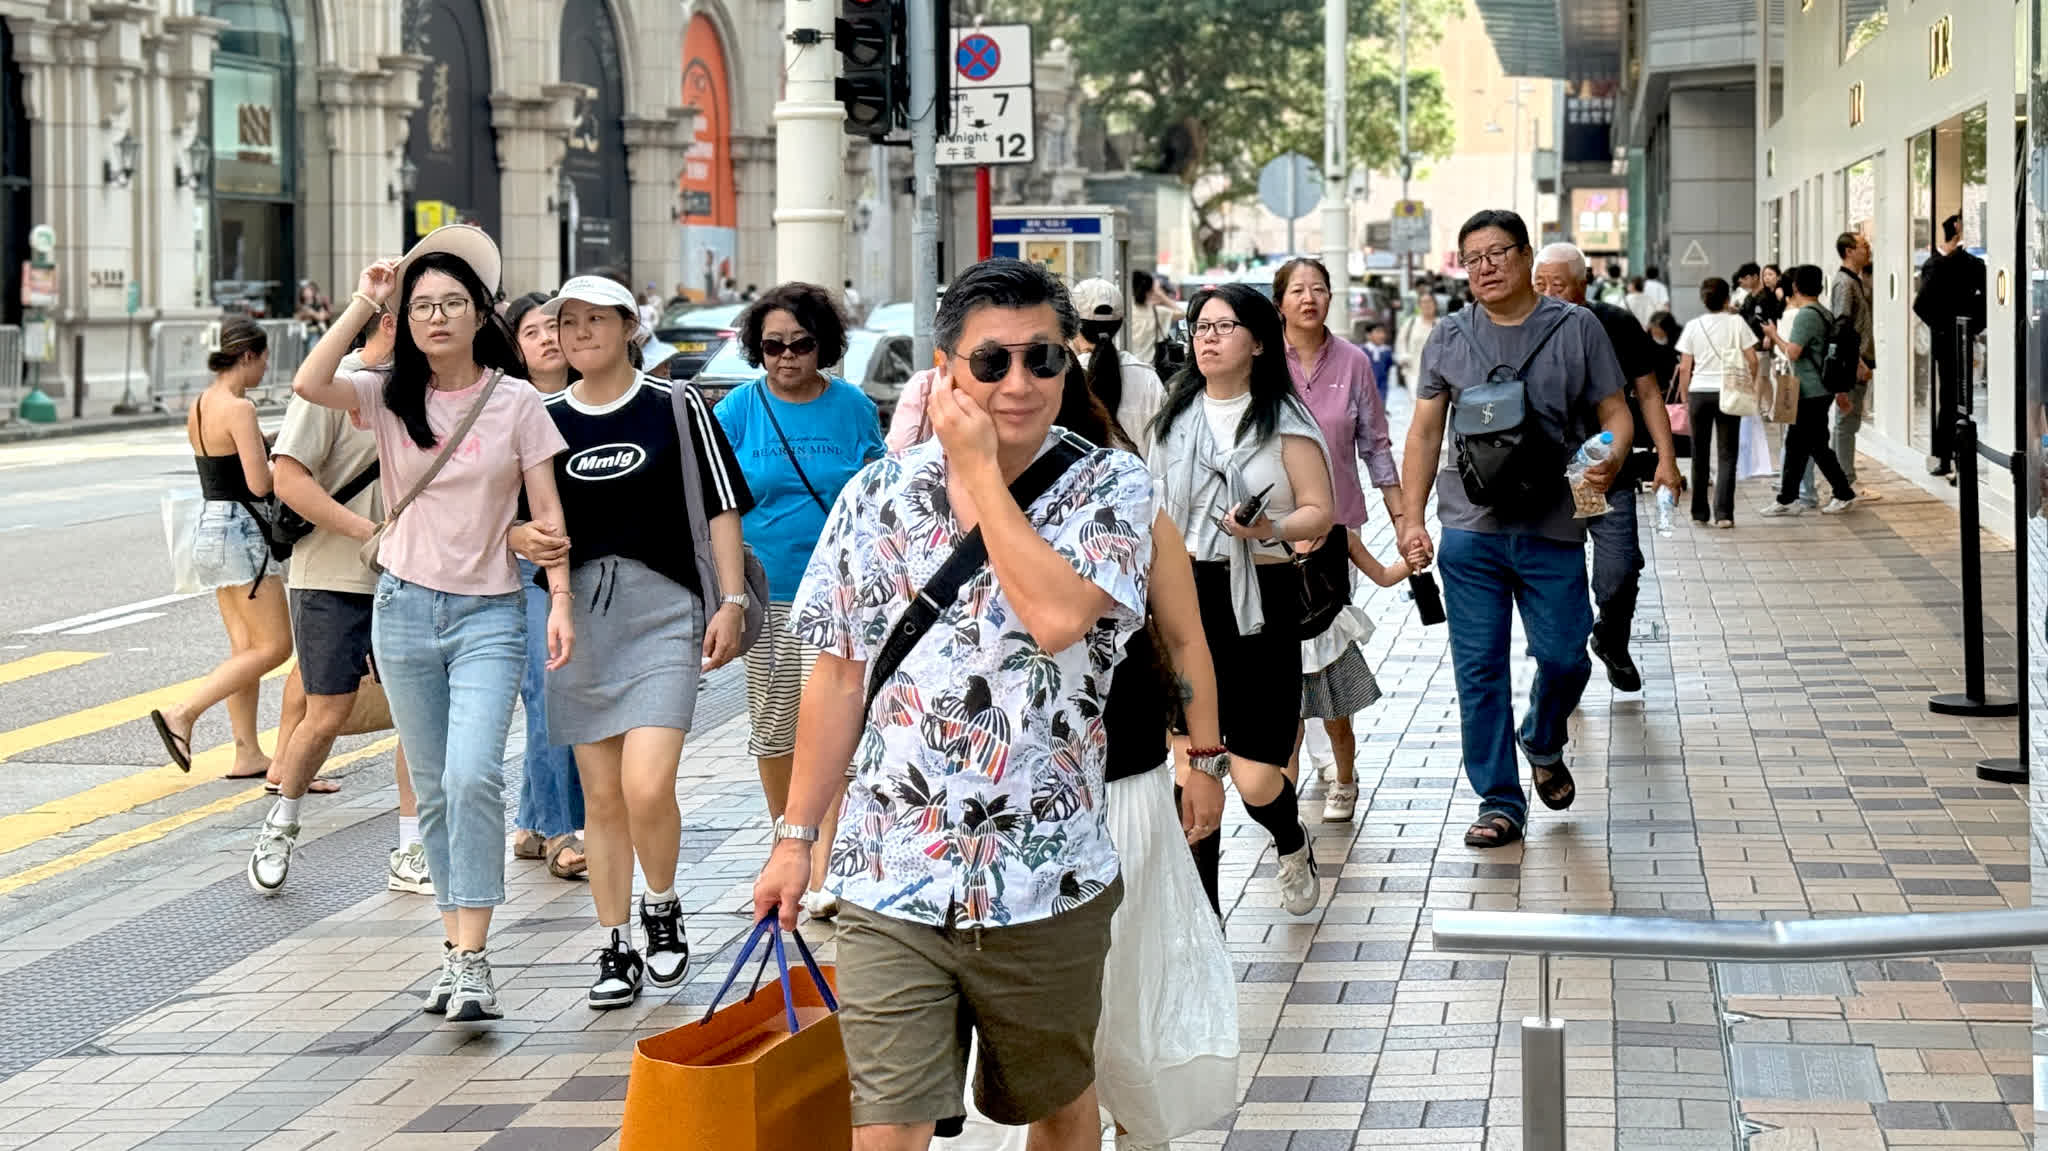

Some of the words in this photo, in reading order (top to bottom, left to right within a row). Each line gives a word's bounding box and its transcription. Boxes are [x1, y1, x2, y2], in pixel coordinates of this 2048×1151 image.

[993, 93, 1009, 117] 7
[946, 147, 976, 159] 午夜
[995, 133, 1026, 158] 12
[752, 446, 787, 458] BEAR
